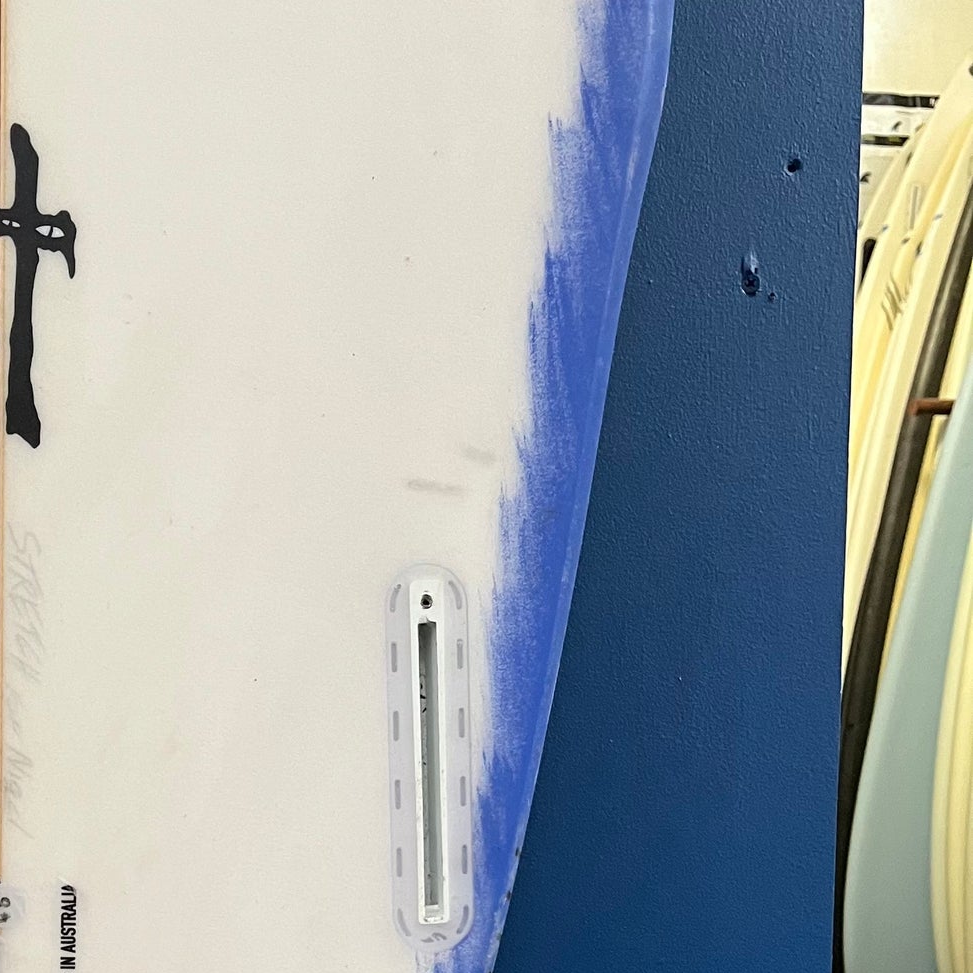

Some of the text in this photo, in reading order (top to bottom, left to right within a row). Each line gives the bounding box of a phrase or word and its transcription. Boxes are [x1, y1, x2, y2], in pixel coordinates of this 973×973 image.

[6, 521, 47, 686] STRETCH
[59, 885, 77, 954] AUSTRALIA
[59, 957, 75, 970] IN
